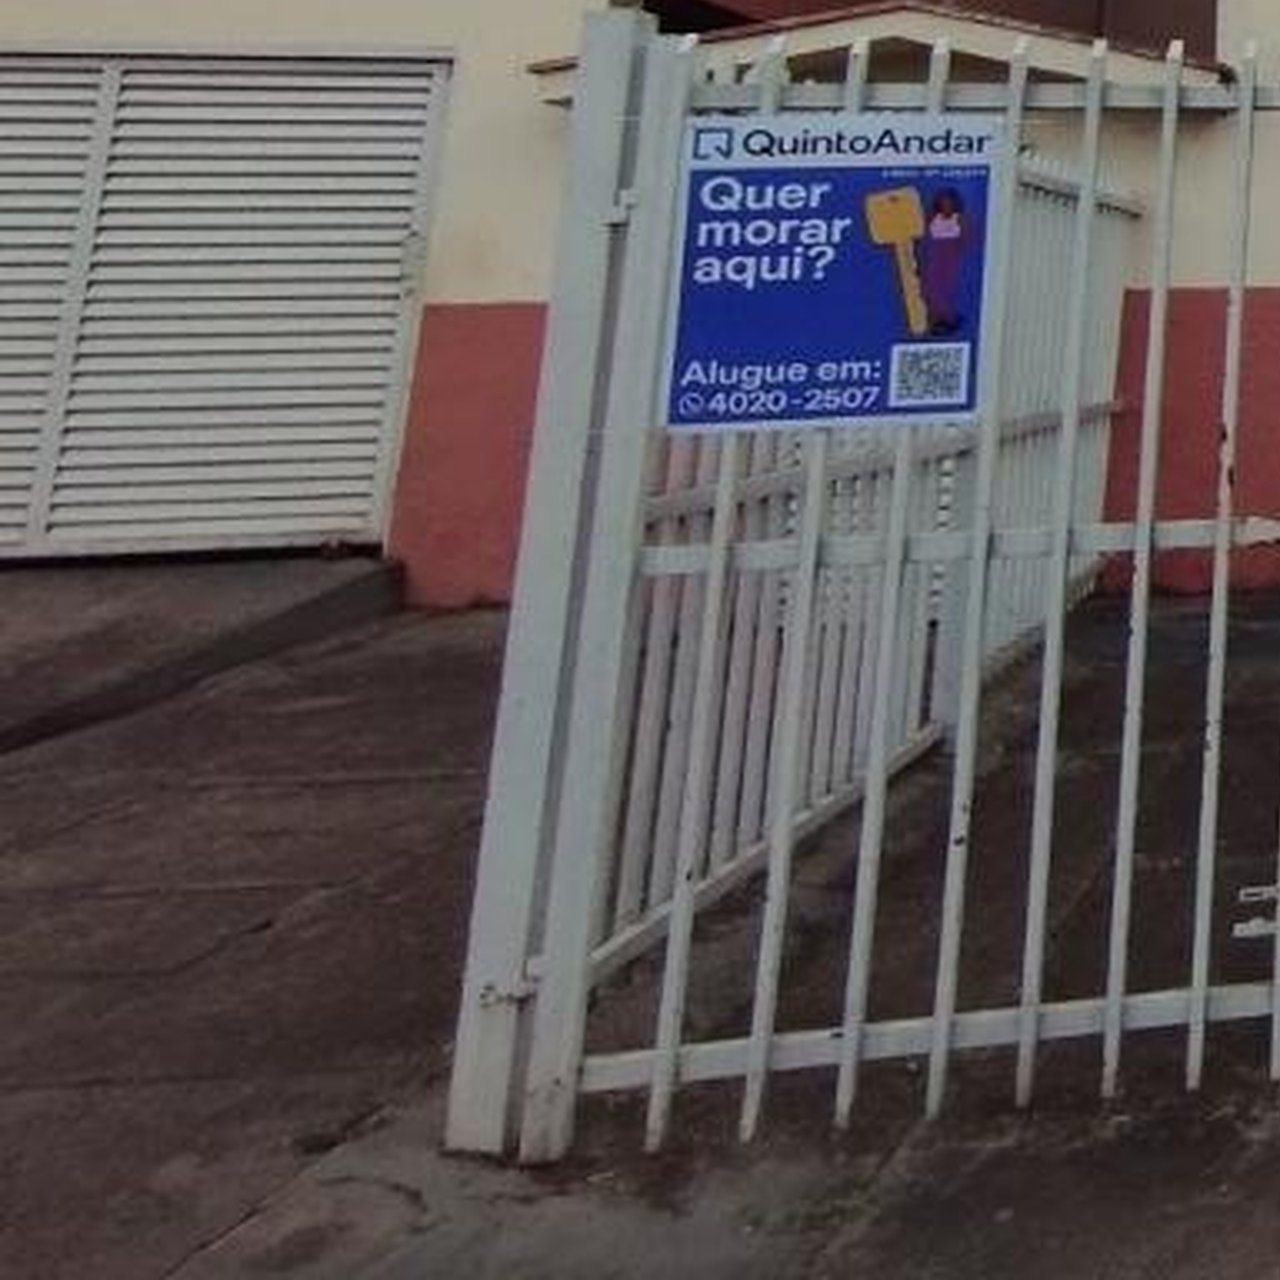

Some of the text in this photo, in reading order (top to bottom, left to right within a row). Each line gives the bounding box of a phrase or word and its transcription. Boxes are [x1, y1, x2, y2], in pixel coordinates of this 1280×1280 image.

[742, 129, 993, 157] QuintoAndar
[700, 176, 831, 211] Quer
[697, 218, 851, 247] morar
[693, 246, 835, 290] aqui?
[680, 360, 881, 390] Alugue em:
[708, 386, 880, 414] 4020-2507
